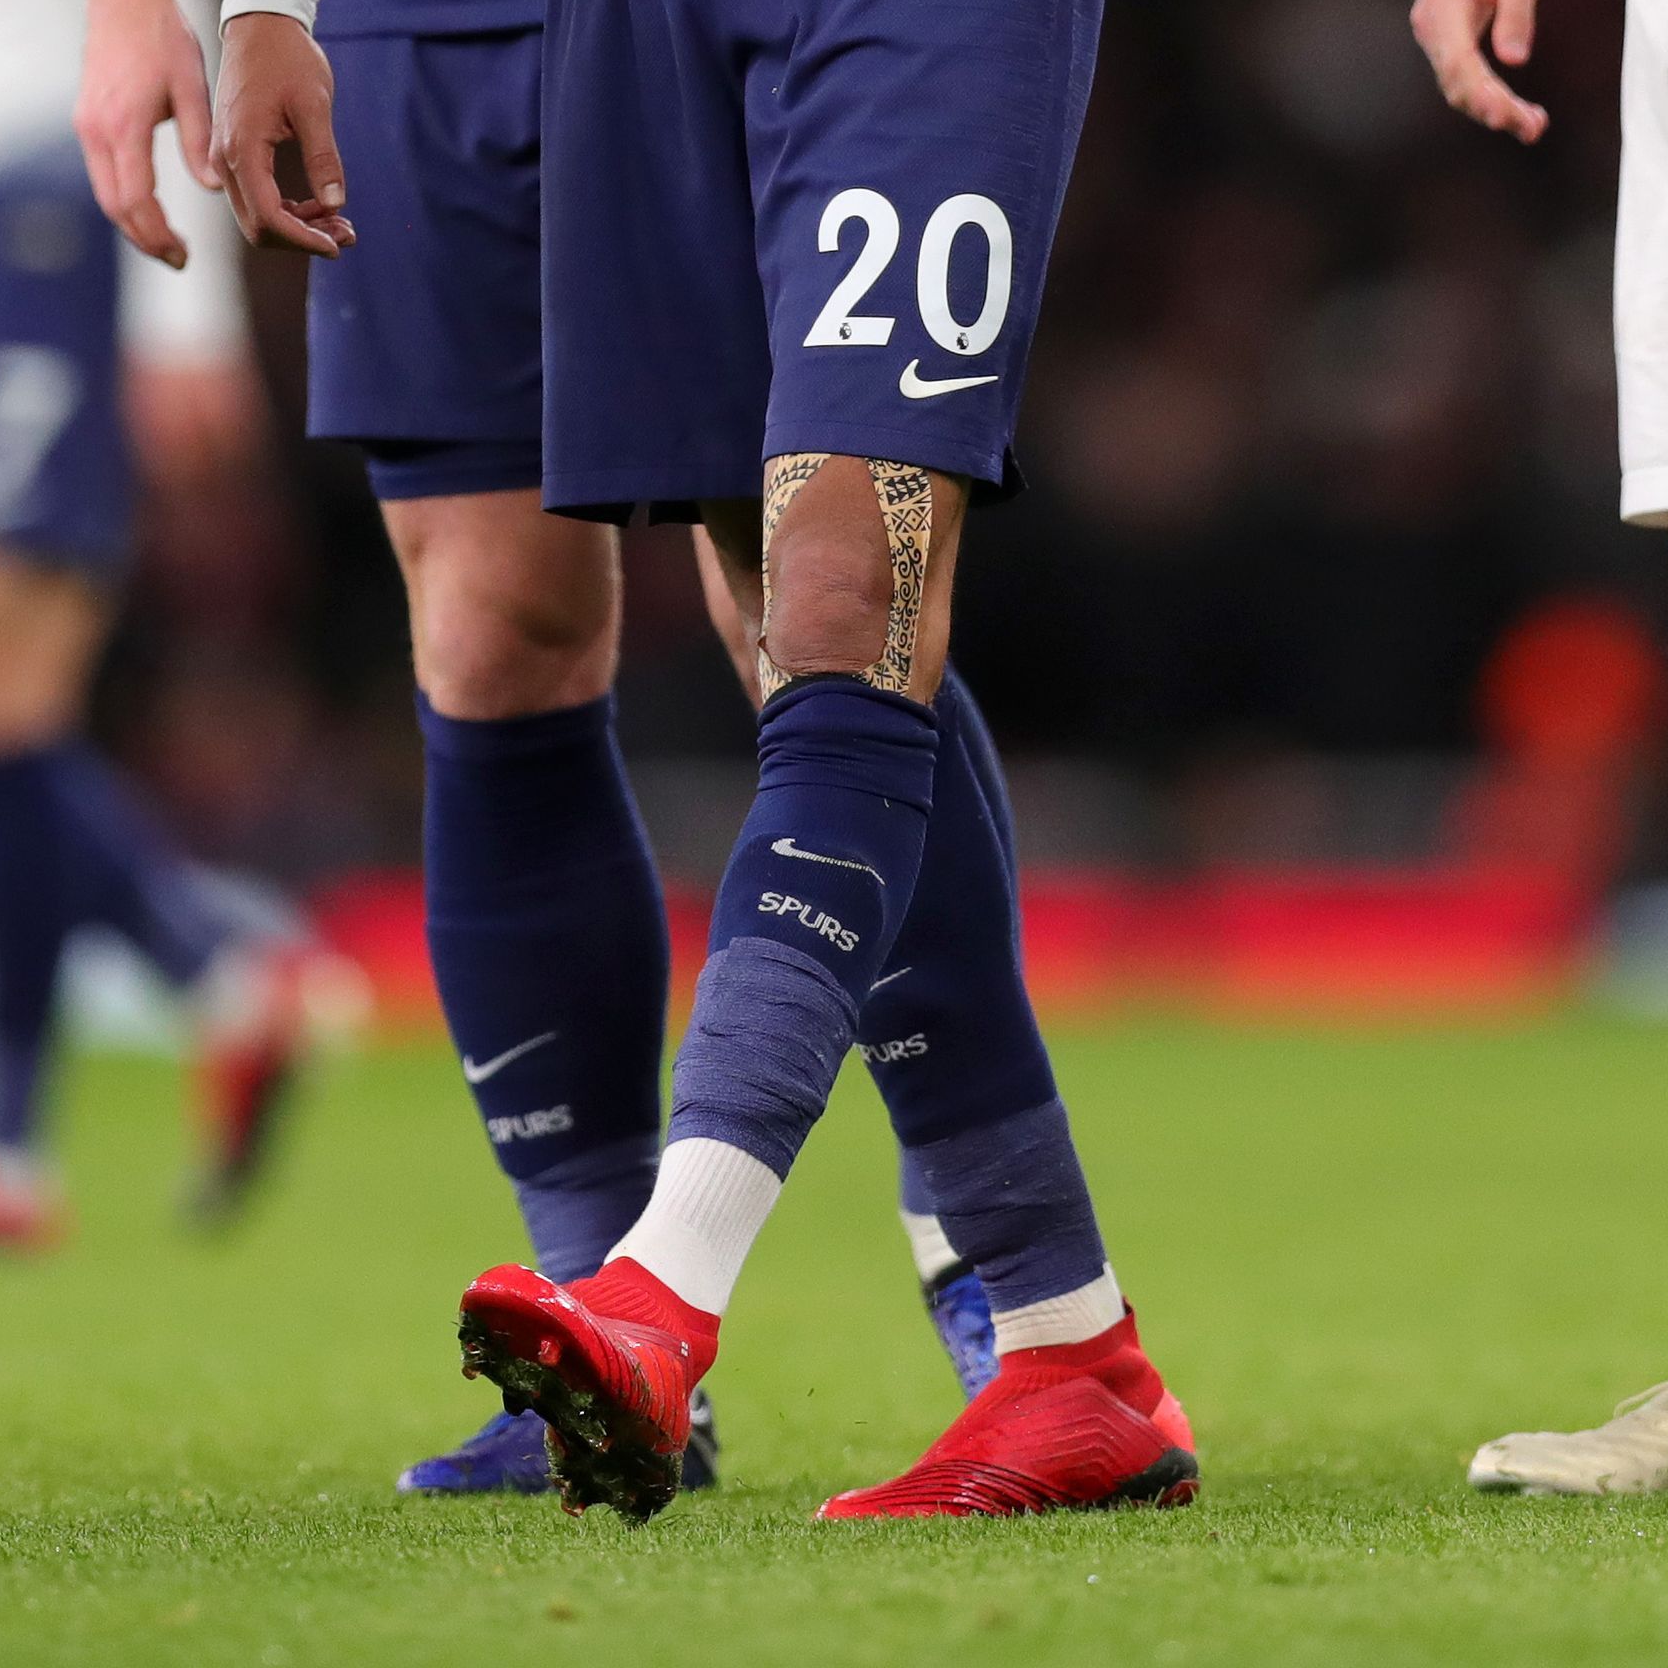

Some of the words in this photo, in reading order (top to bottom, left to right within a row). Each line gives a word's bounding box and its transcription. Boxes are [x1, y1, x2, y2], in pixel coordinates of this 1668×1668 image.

[802, 187, 1013, 356] 20
[757, 891, 860, 952] SPURS
[859, 1032, 929, 1064] PURS
